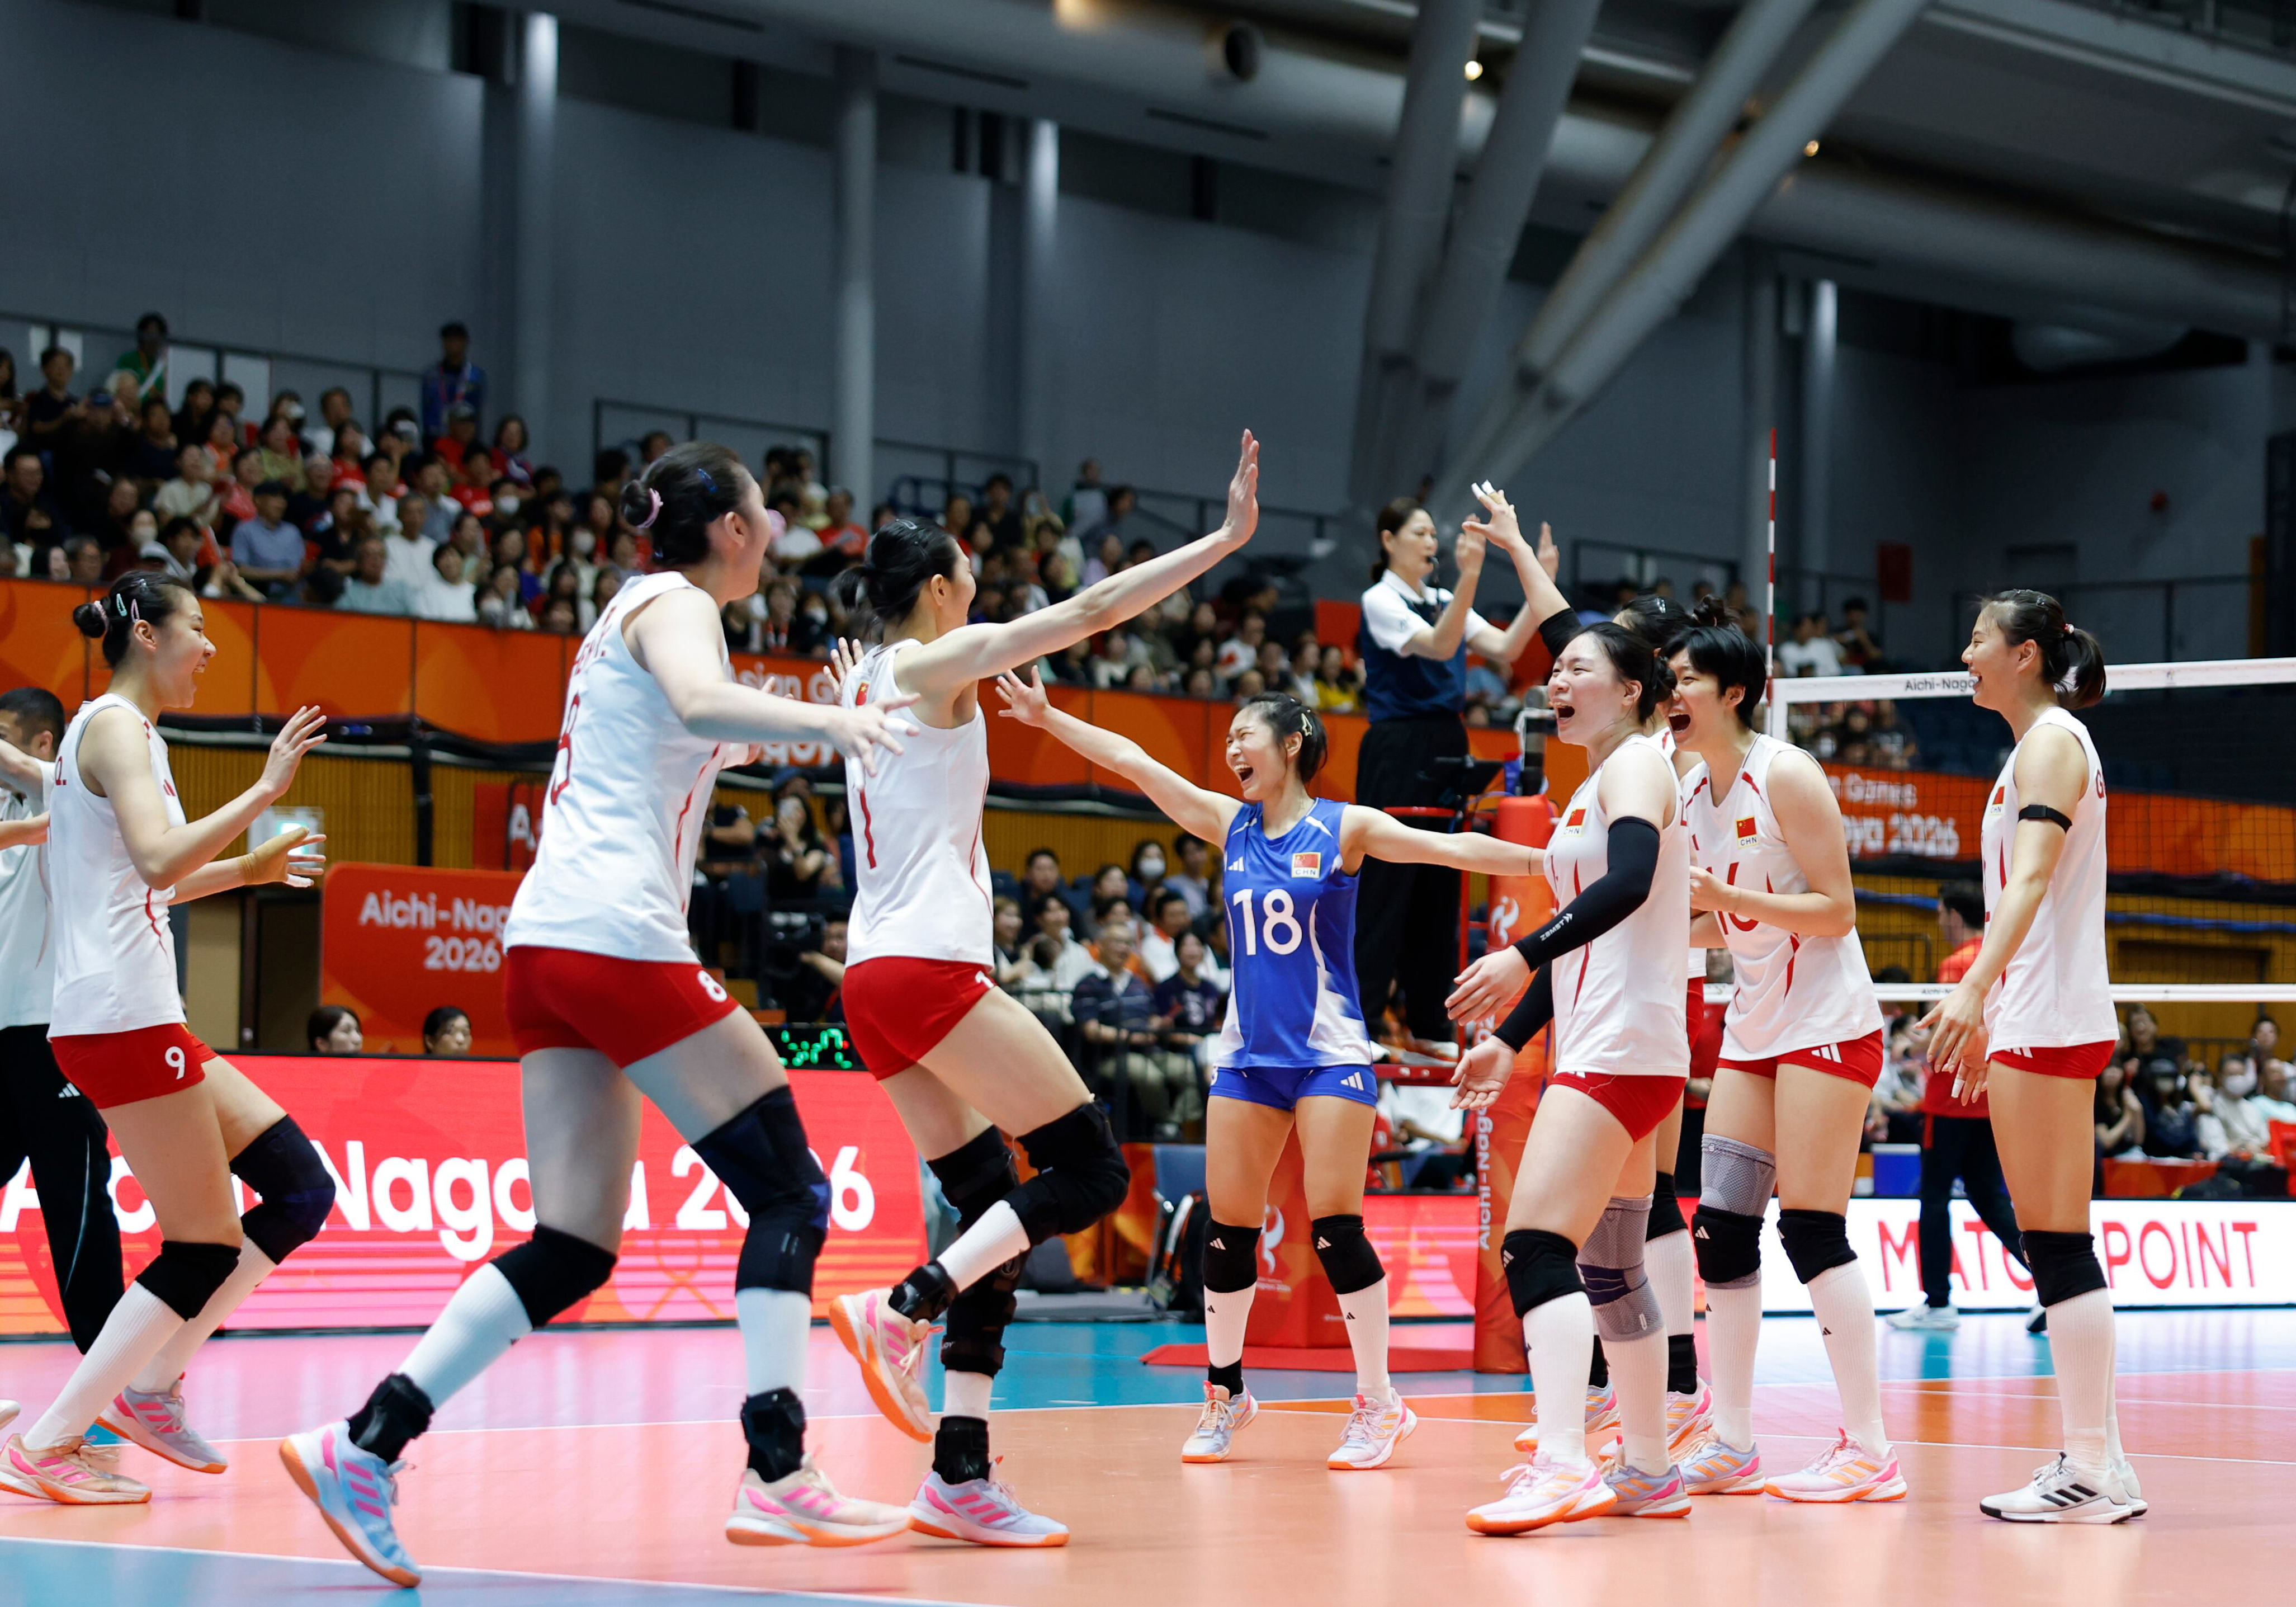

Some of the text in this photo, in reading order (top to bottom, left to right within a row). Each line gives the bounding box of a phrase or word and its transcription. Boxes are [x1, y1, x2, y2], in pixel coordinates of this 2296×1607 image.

[1905, 677, 1977, 692] Aichi-Nago
[1740, 837, 1757, 846] CHN
[1888, 813, 1960, 858] 2026
[358, 889, 511, 941] Aichi-Nag
[1233, 888, 1302, 956] 18
[424, 935, 502, 973] 2026
[697, 970, 727, 1002] 8
[165, 1046, 185, 1080] 9
[2102, 1220, 2257, 1289] POINT
